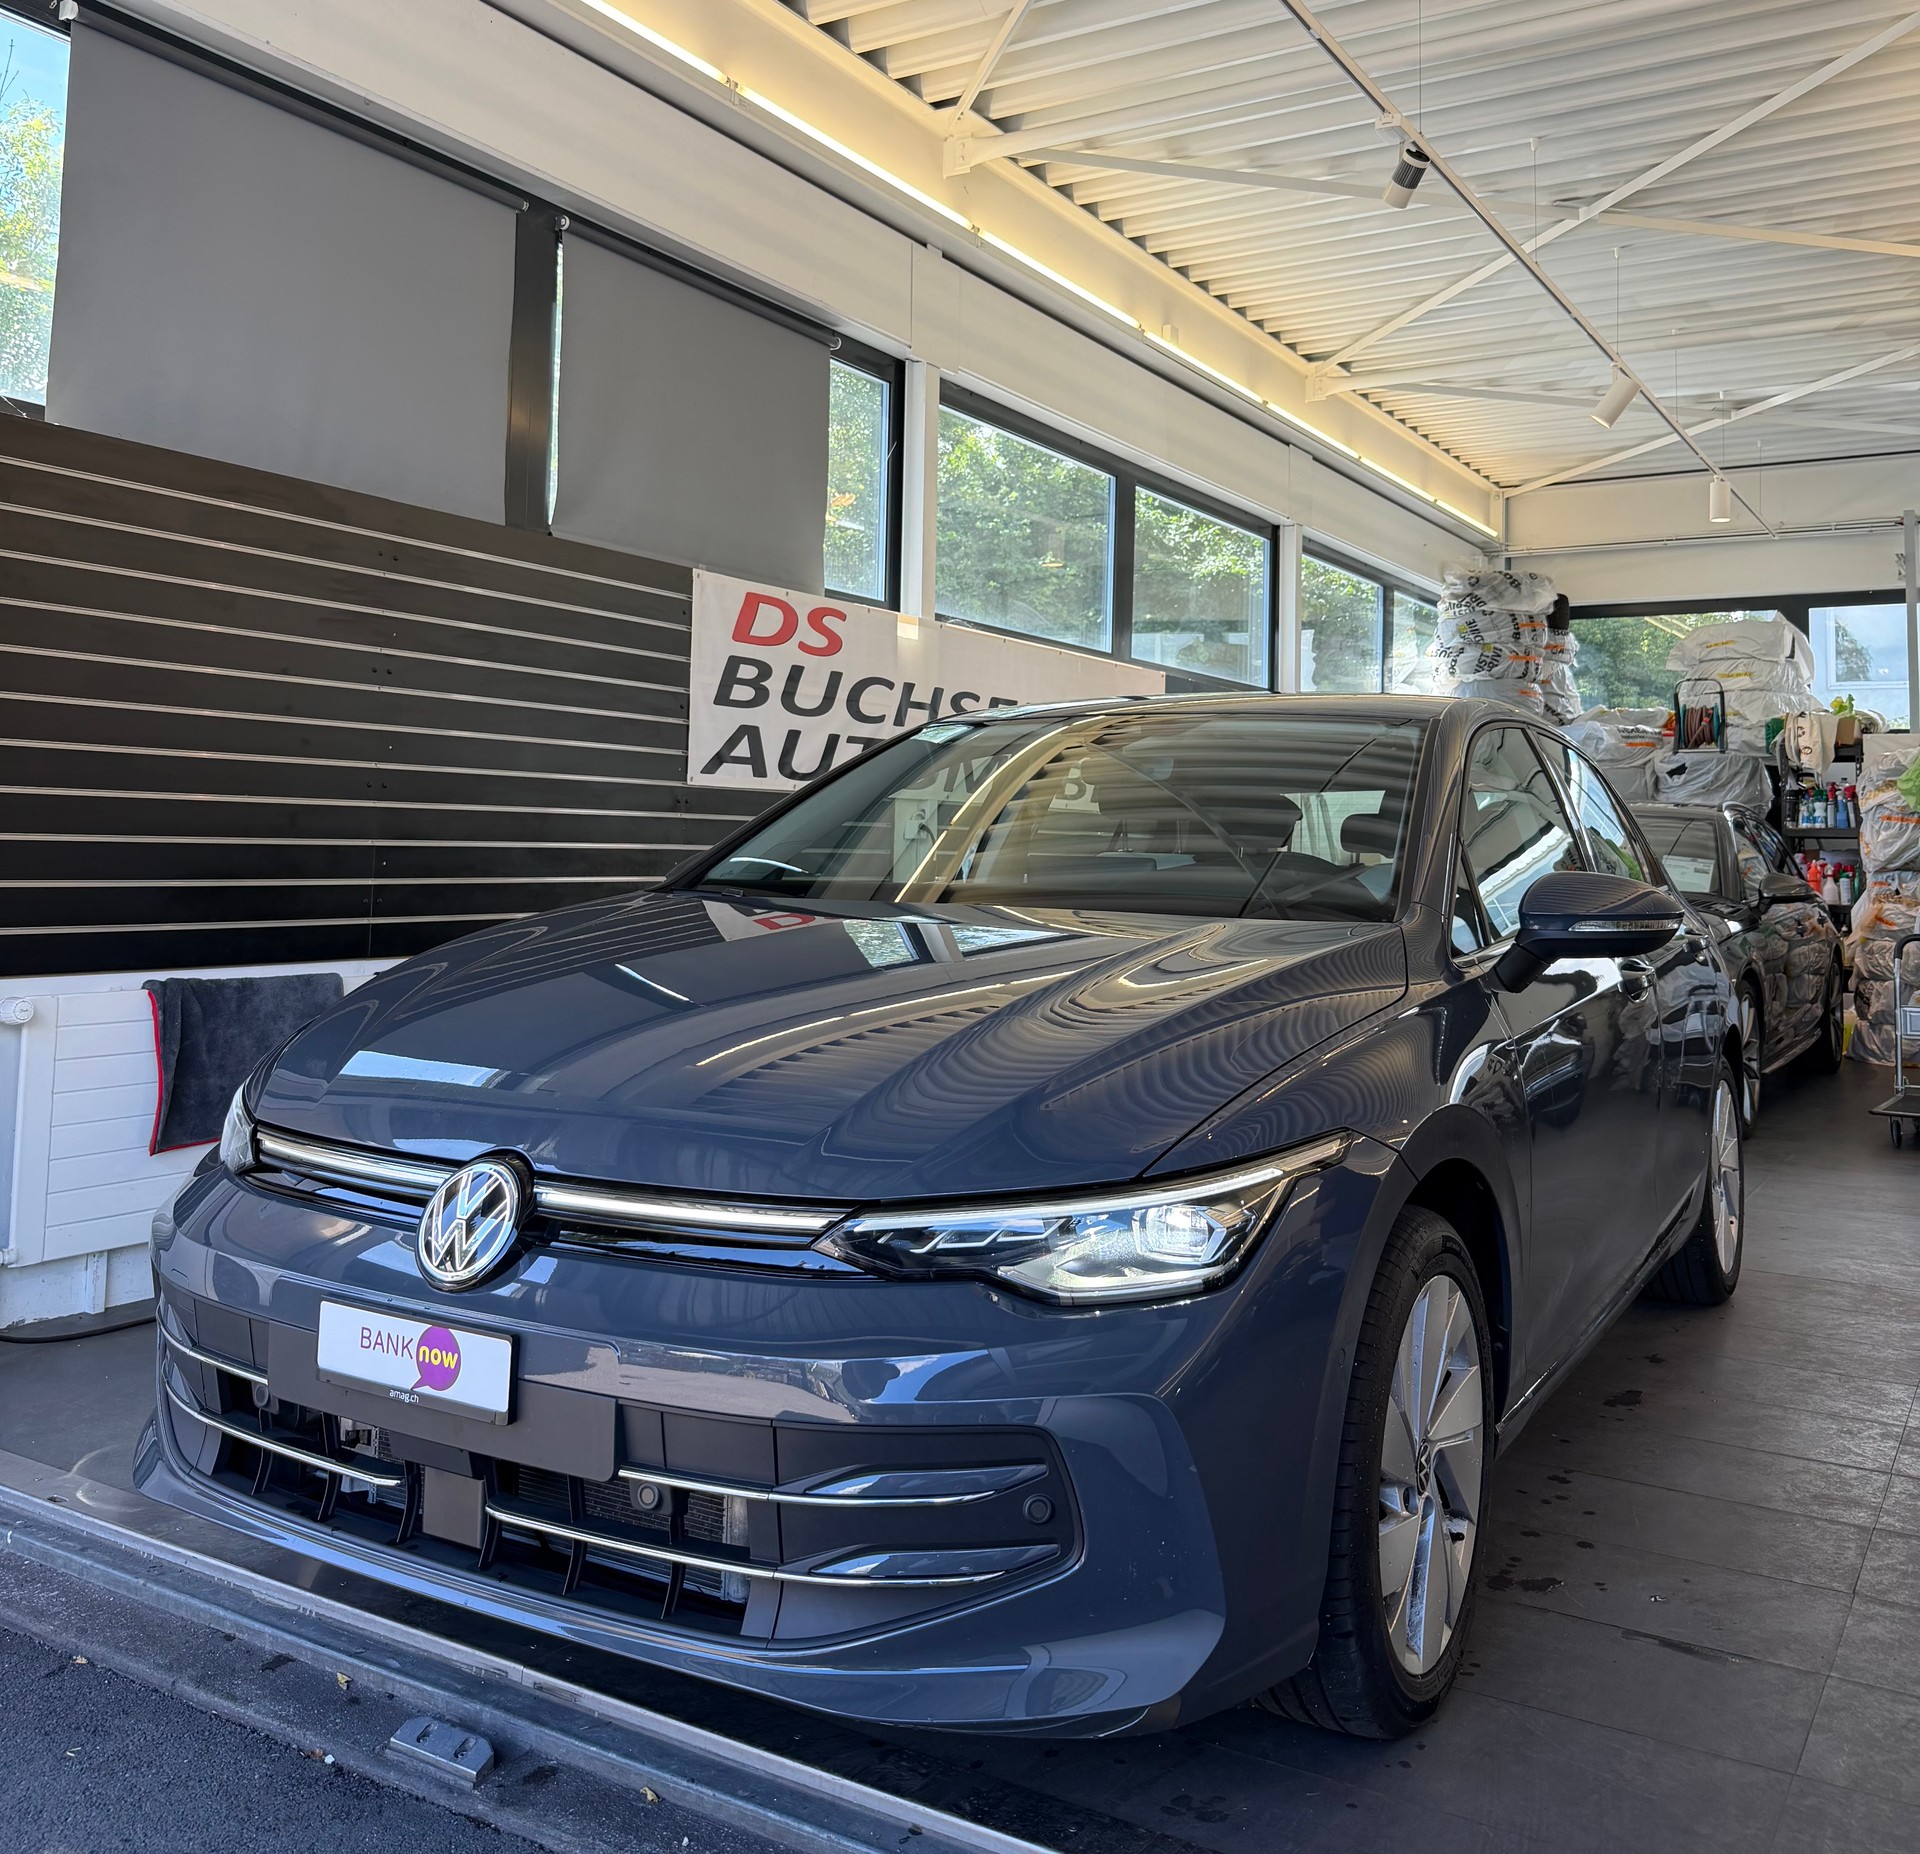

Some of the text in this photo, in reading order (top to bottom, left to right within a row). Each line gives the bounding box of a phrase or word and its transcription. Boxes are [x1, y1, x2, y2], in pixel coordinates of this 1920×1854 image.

[732, 591, 847, 657] DS
[360, 1326, 459, 1370] BANK now
[389, 1388, 419, 1404] amag.ch
